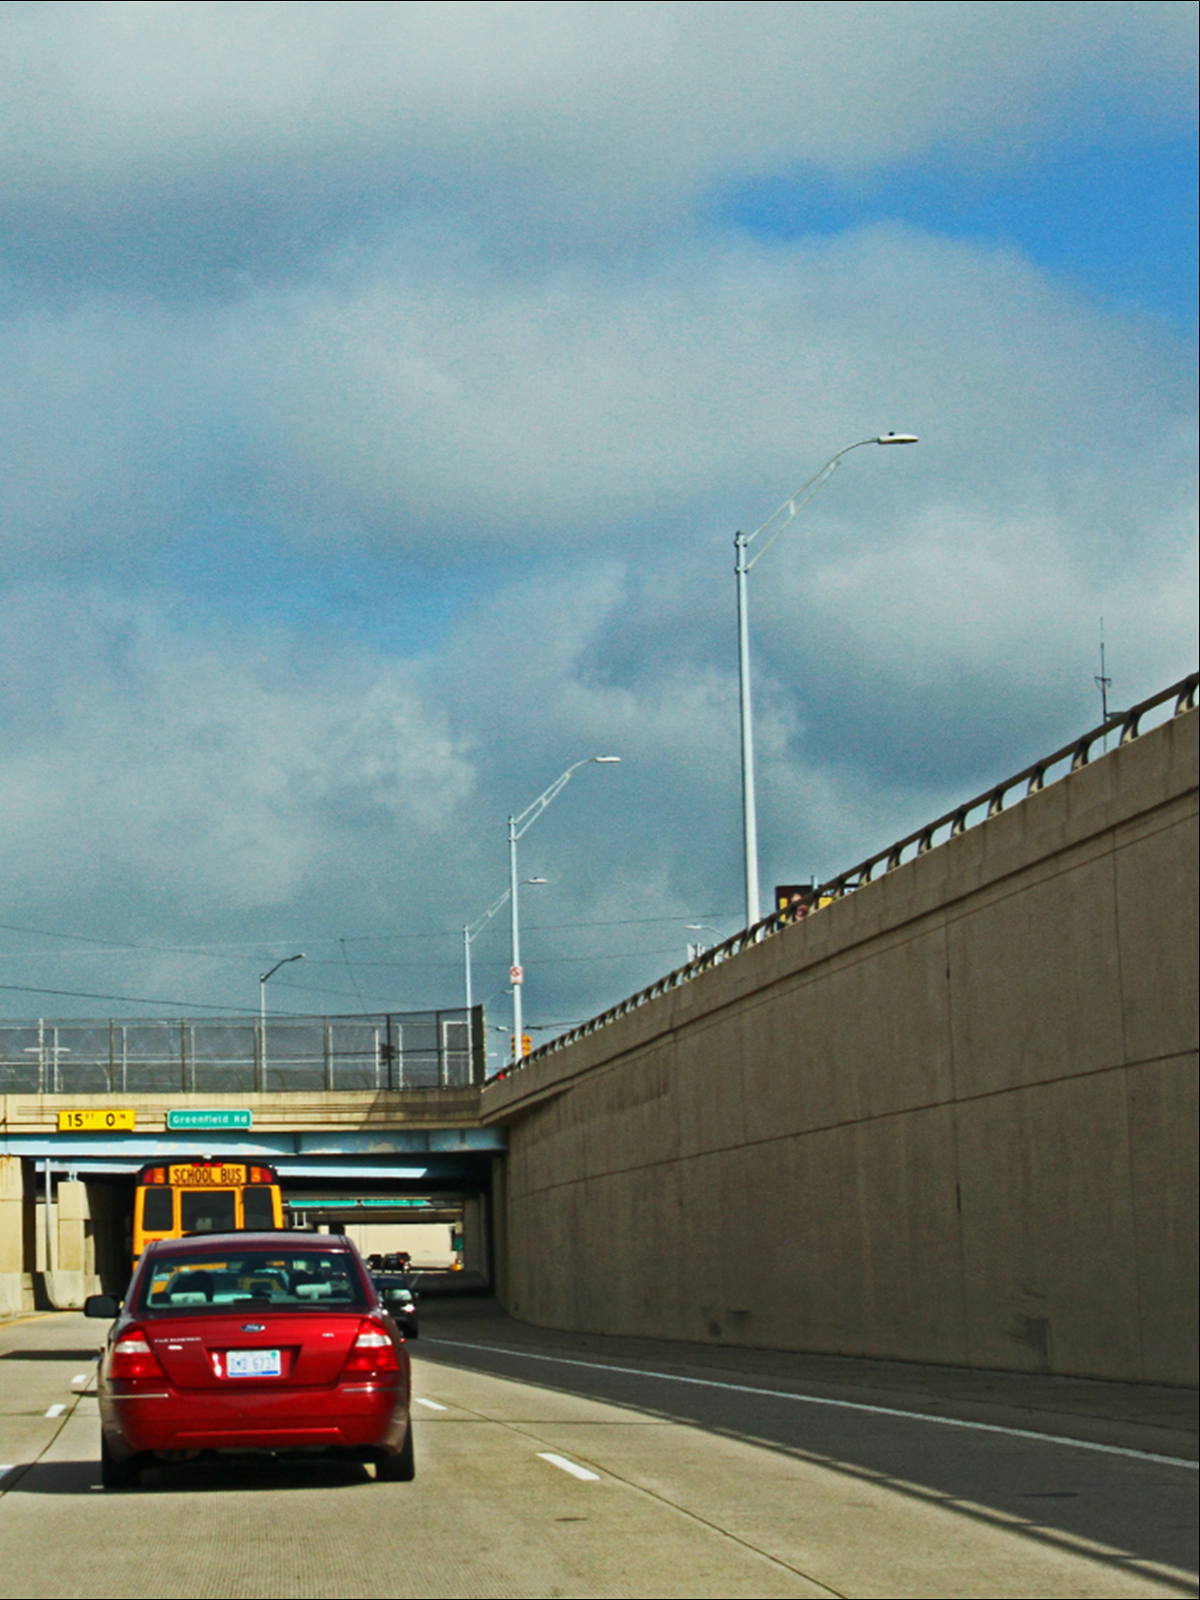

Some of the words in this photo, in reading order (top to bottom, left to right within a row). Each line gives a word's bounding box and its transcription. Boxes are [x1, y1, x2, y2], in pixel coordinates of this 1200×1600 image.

[67, 1113, 84, 1127] 15
[106, 1112, 116, 1127] 0
[172, 1114, 229, 1124] Greenfield
[234, 1114, 248, 1124] Rd
[173, 1168, 215, 1183] SCHOOL
[221, 1168, 242, 1183] BUS
